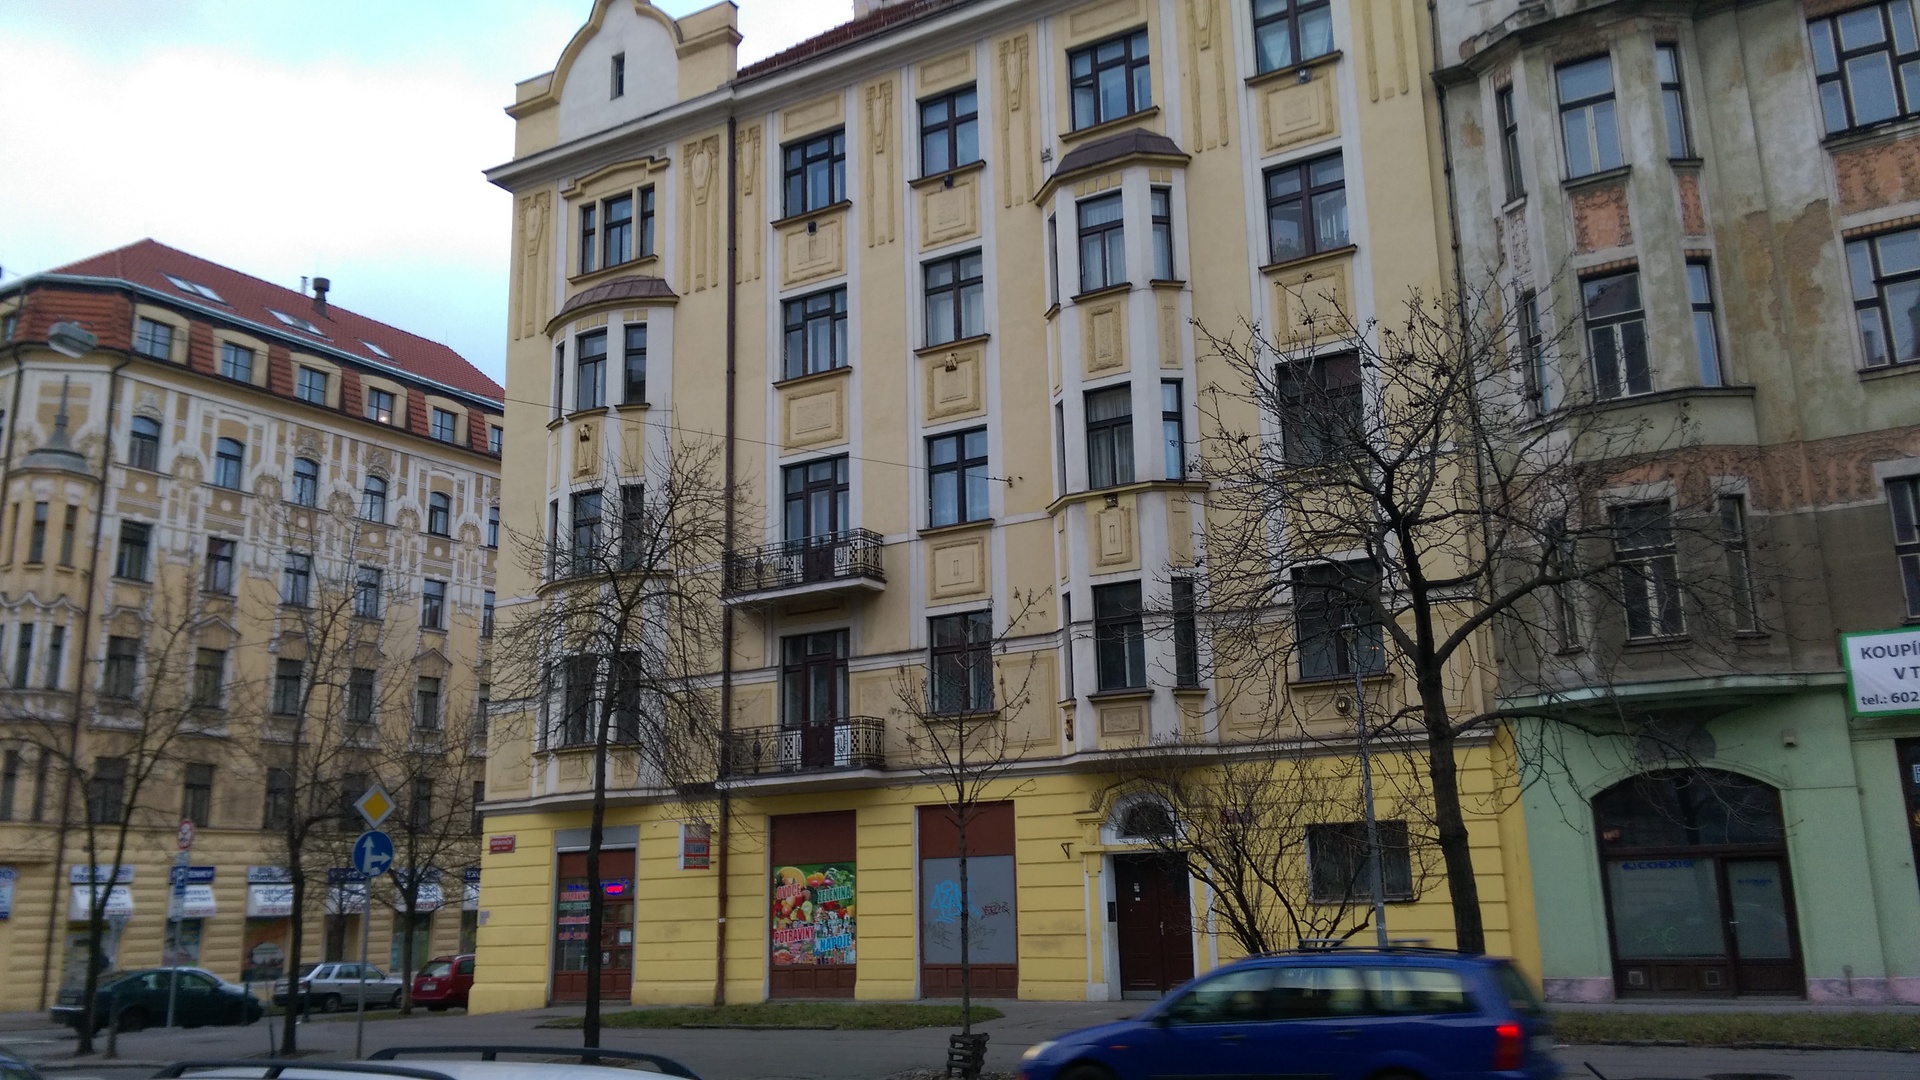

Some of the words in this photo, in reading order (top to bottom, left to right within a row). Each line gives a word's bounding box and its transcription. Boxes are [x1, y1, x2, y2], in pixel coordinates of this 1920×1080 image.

[1861, 641, 1920, 659] KOUPÍ
[1894, 667, 1906, 680] V
[1861, 694, 1887, 705] tel.:
[1891, 691, 1919, 704] 602
[776, 885, 801, 899] OVOCE
[818, 886, 852, 904] ZELENINA
[774, 926, 815, 943] POTRAVINY
